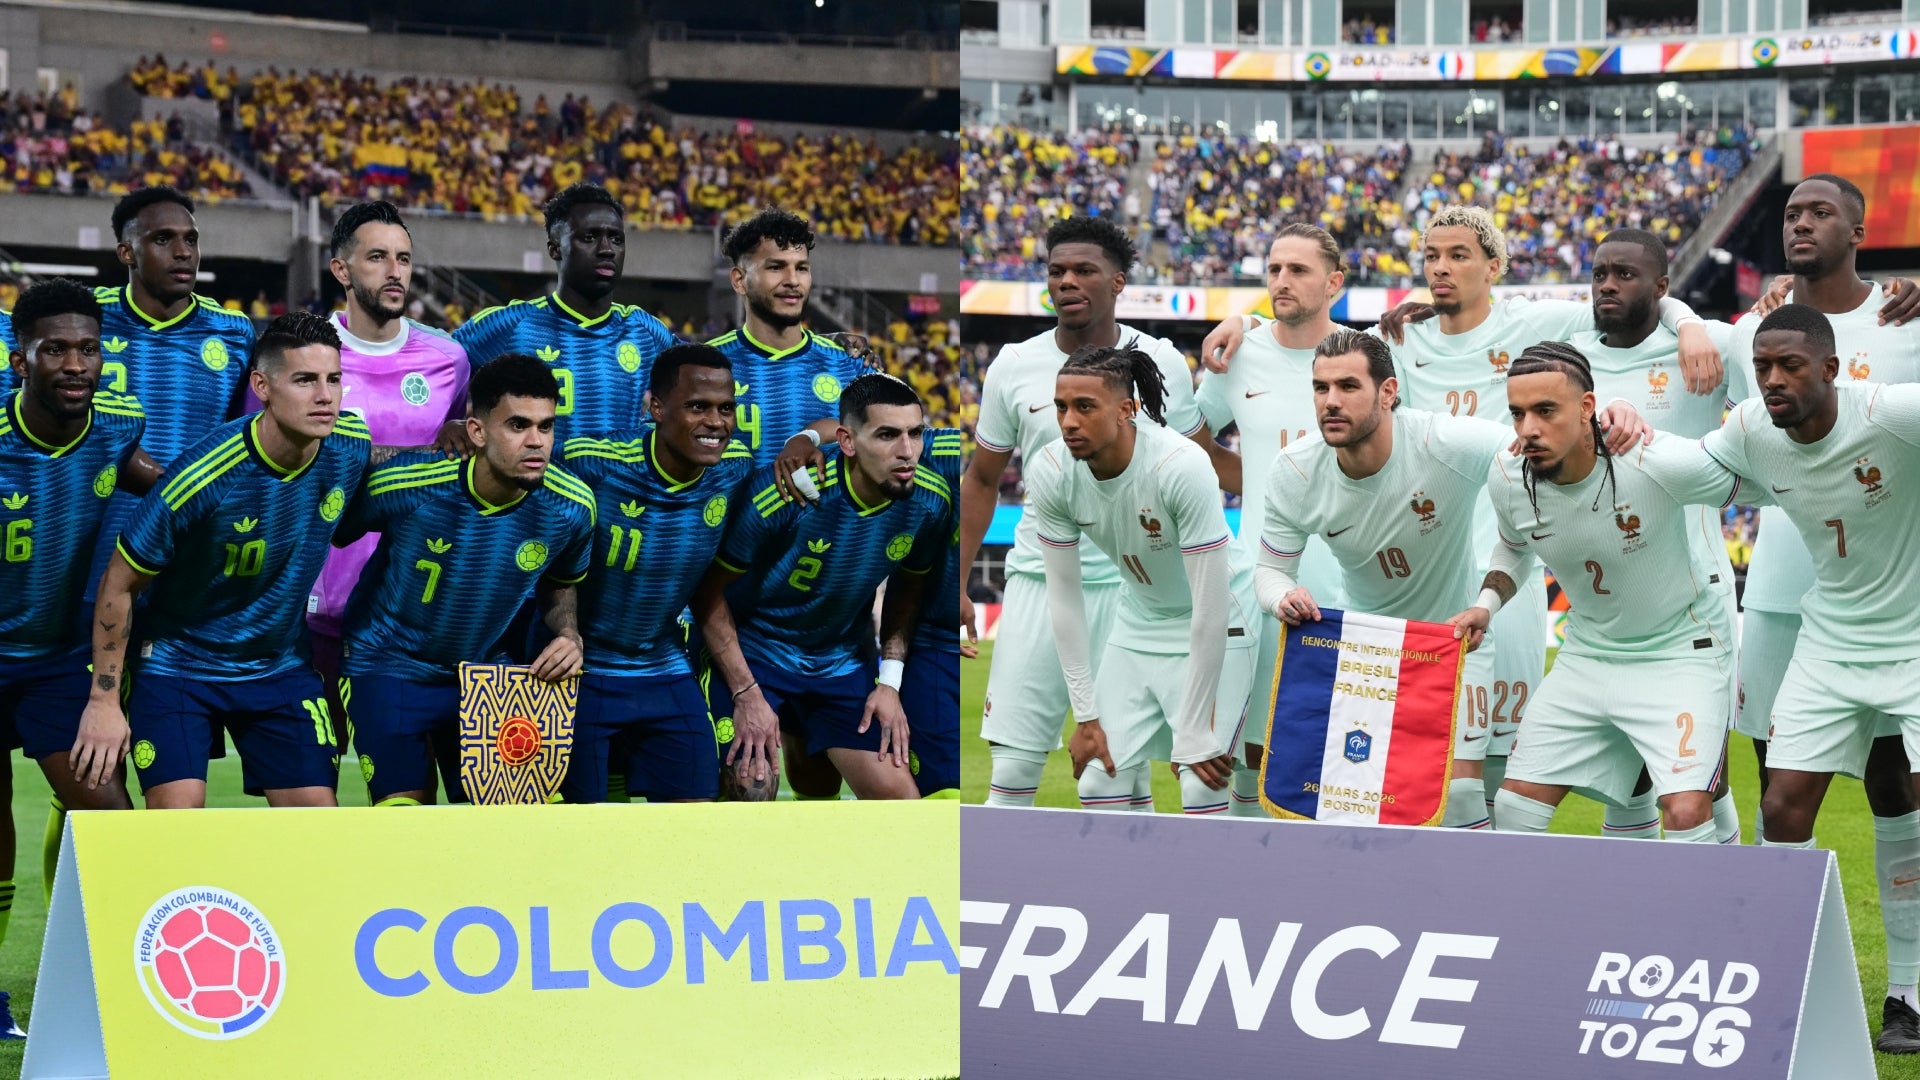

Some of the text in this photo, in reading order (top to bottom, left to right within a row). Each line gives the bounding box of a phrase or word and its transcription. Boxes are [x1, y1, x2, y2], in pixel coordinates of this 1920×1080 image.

[223, 538, 267, 578] 10
[605, 524, 643, 573] 11
[1824, 518, 1847, 559] 7
[415, 558, 443, 605] 7
[788, 555, 823, 593] 2
[1122, 554, 1153, 586] 11
[1376, 547, 1412, 580] 19
[1584, 560, 1611, 595] 2
[1301, 635, 1442, 664] RENCONTRE INTERNATIONALE
[1333, 681, 1398, 702] FRANCE
[1465, 684, 1489, 729] 19
[1492, 680, 1528, 723] 22
[1676, 712, 1697, 757] 2
[1302, 781, 1396, 805] 26 MARS 2026
[1323, 799, 1377, 815] BOSTON
[171, 892, 239, 913] COLOMBIANA
[239, 906, 254, 921] DE
[251, 917, 278, 958] FÚTBOL
[354, 896, 960, 998] COLOMBIA
[1587, 951, 1760, 1005] ROAD
[1578, 1001, 1752, 1068] TO 26
